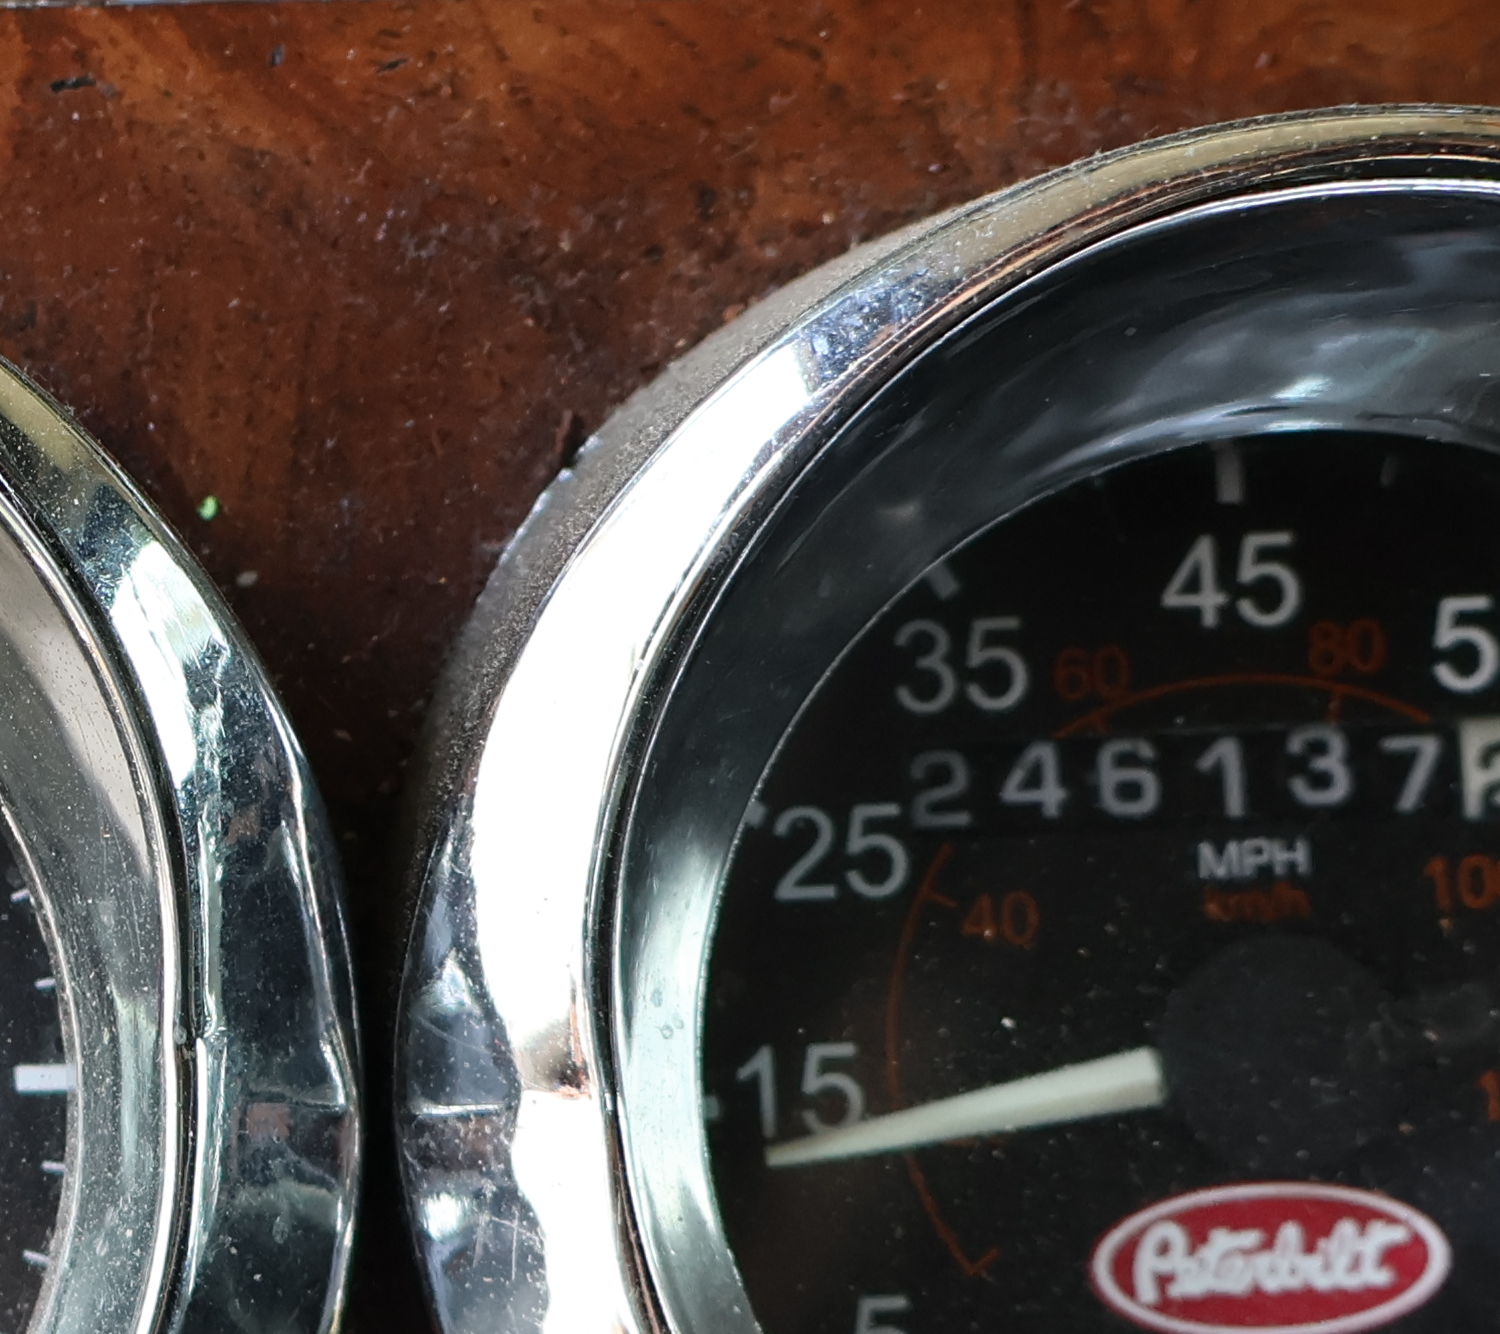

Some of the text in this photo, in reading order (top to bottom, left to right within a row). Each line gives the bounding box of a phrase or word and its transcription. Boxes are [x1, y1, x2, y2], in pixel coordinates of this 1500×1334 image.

[1160, 530, 1302, 629] 45
[894, 617, 1030, 714] 35
[1054, 644, 1131, 701] 60
[1307, 617, 1388, 676] 80
[773, 802, 910, 901] 25
[1198, 837, 1313, 880] MPH
[961, 890, 1041, 949] 40
[736, 1041, 866, 1139] 15
[1130, 1217, 1410, 1307] Peterbilt
